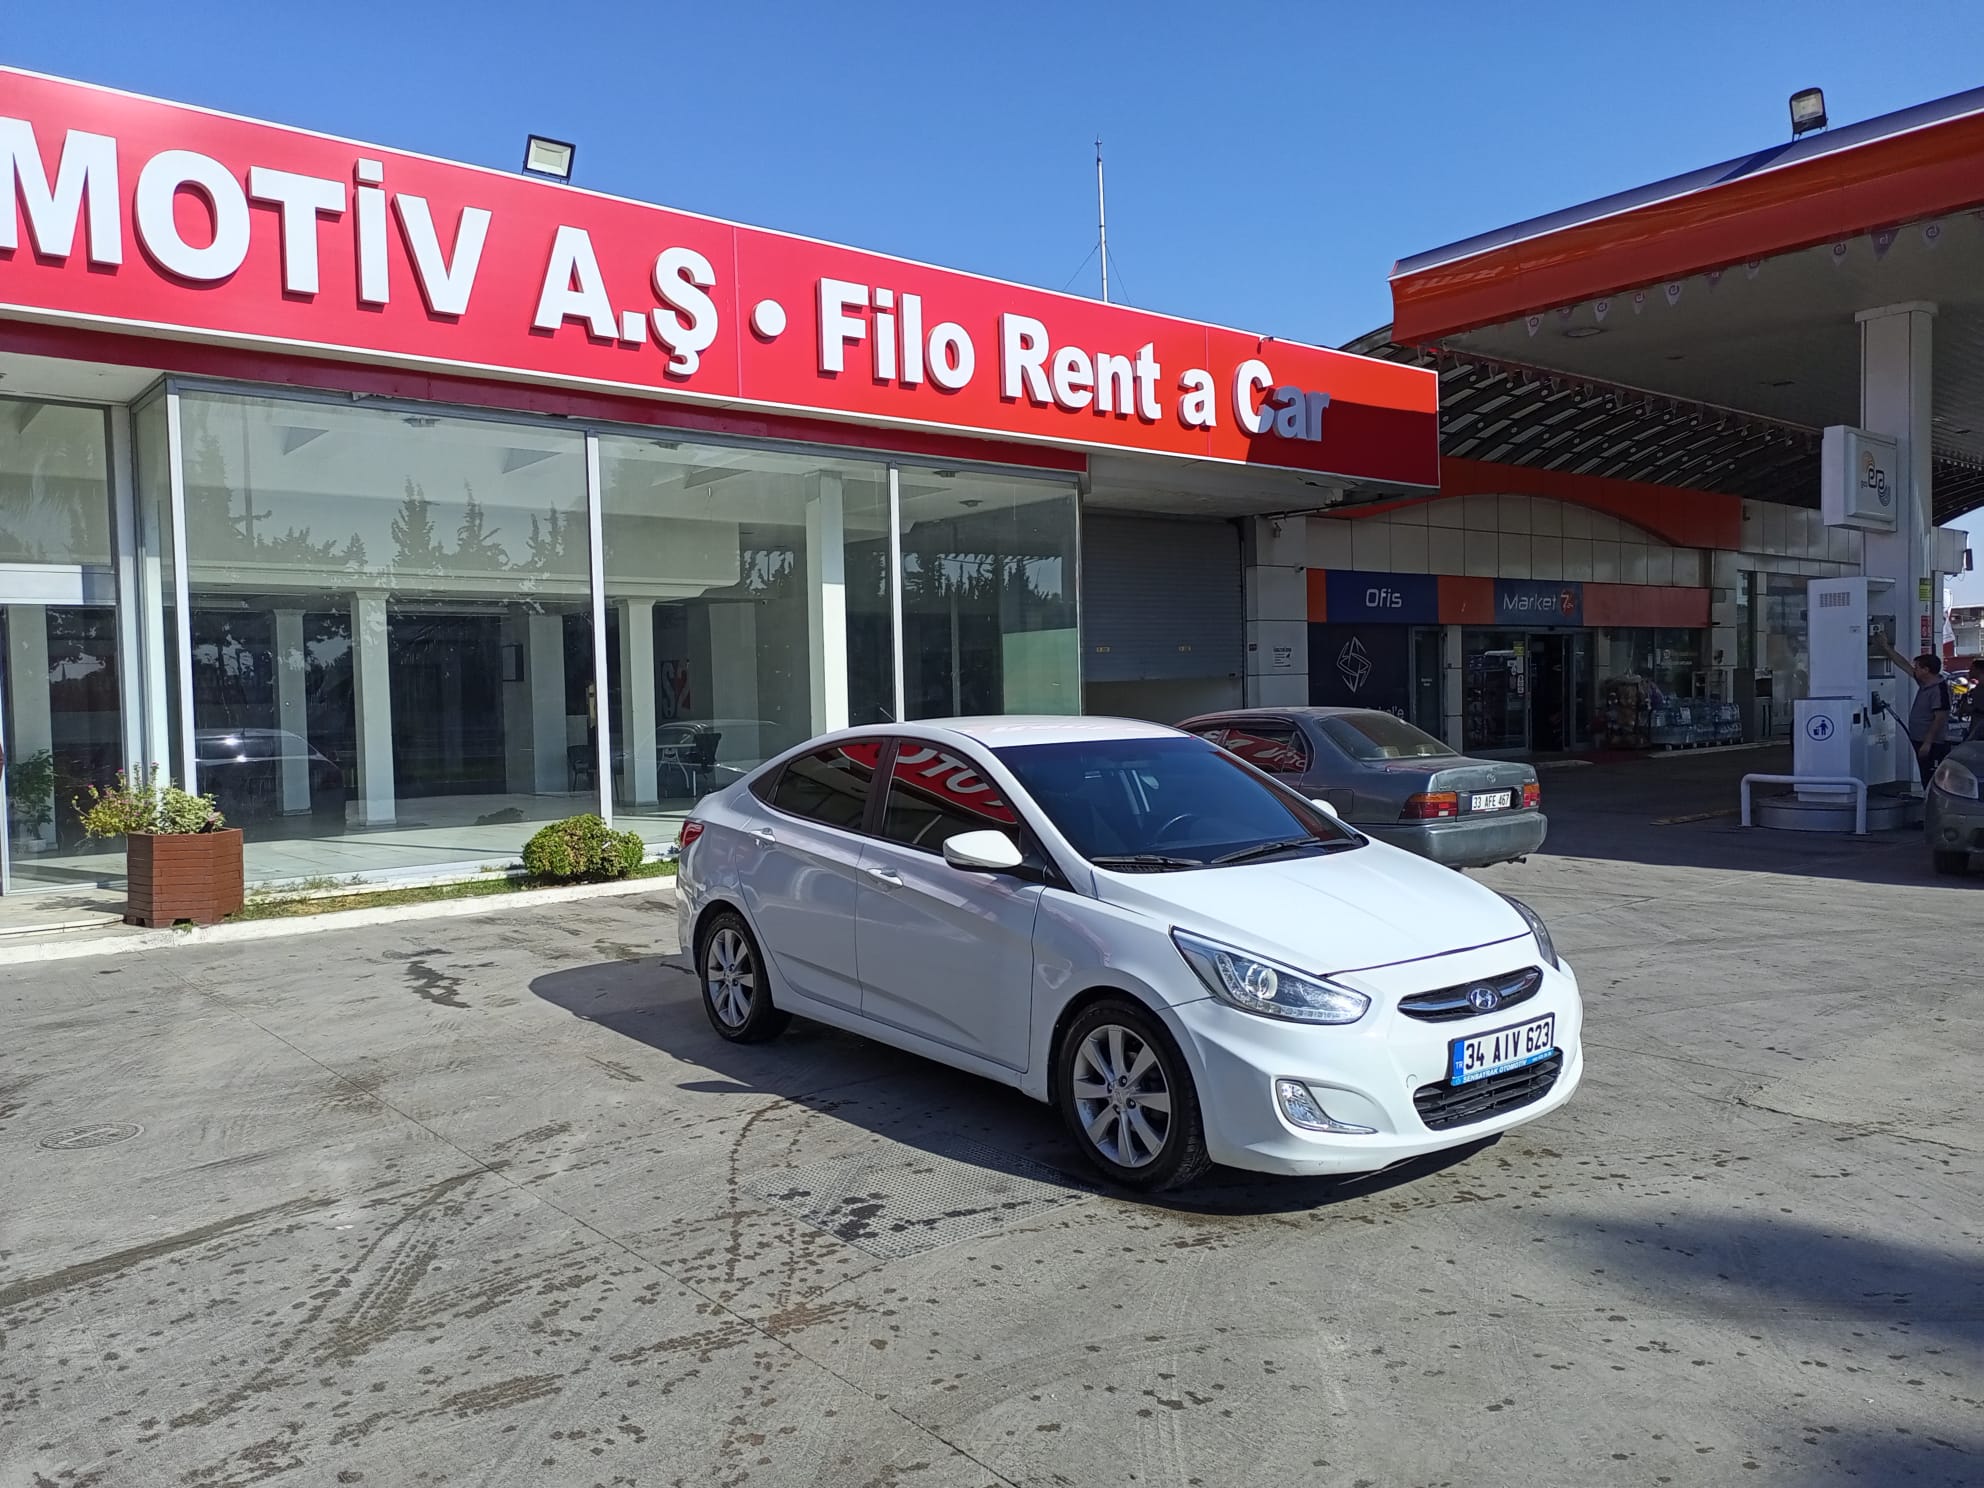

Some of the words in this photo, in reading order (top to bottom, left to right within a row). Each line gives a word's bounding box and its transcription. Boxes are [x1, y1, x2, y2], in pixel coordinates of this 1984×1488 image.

[531, 224, 718, 377] A.Ş
[817, 277, 975, 390] Filo
[1000, 312, 1163, 421] Rent
[1177, 367, 1217, 428] a
[1232, 359, 1330, 442] Car
[1365, 588, 1402, 608] Ofis
[1503, 593, 1556, 610] Market
[1473, 796, 1481, 809] 33
[1465, 1041, 1485, 1070] 34
[1493, 1030, 1521, 1063] AIV
[1526, 1021, 1550, 1053] 623
